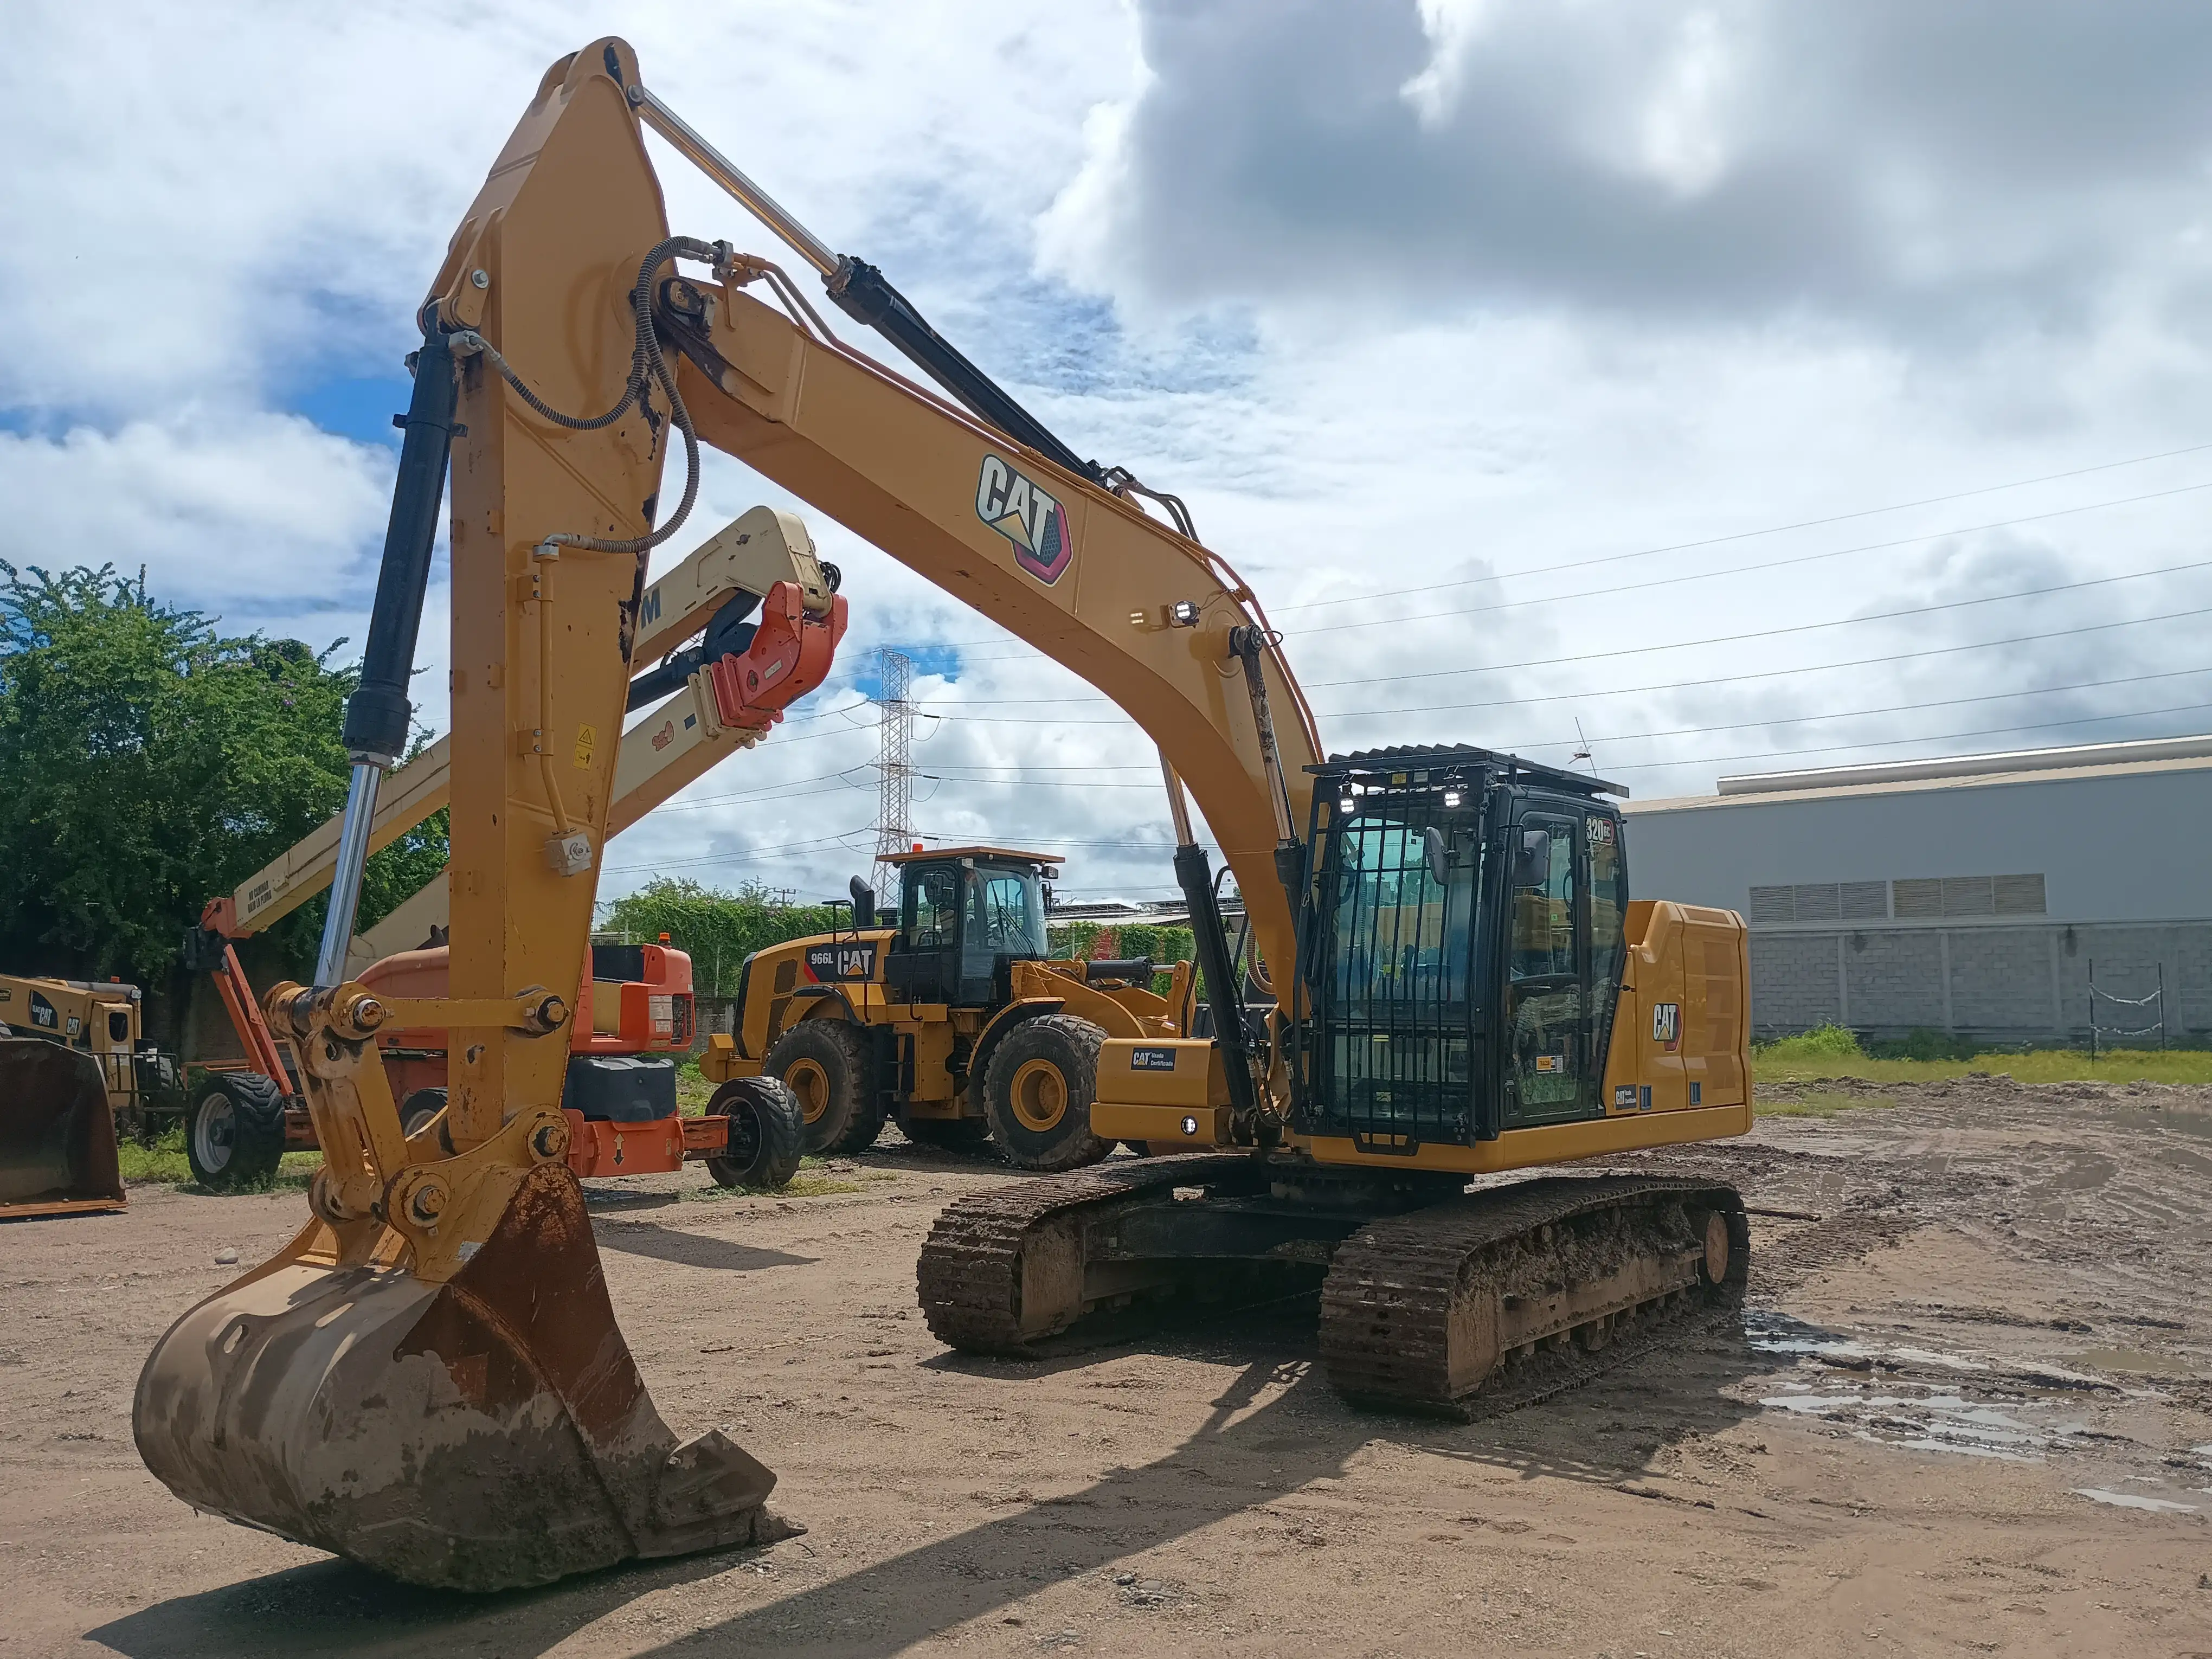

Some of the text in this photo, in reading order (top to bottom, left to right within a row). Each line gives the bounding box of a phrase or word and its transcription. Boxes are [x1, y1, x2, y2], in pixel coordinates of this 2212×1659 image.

[978, 456, 1056, 556] CAT
[1586, 818, 1610, 841] 320 GC
[811, 950, 872, 975] 966L CAT
[38, 1007, 53, 1026] CAT
[67, 1018, 79, 1034] CAT
[1654, 1004, 1676, 1040] CAT
[1133, 1052, 1150, 1065] CAT
[1616, 1090, 1625, 1104] CAT
